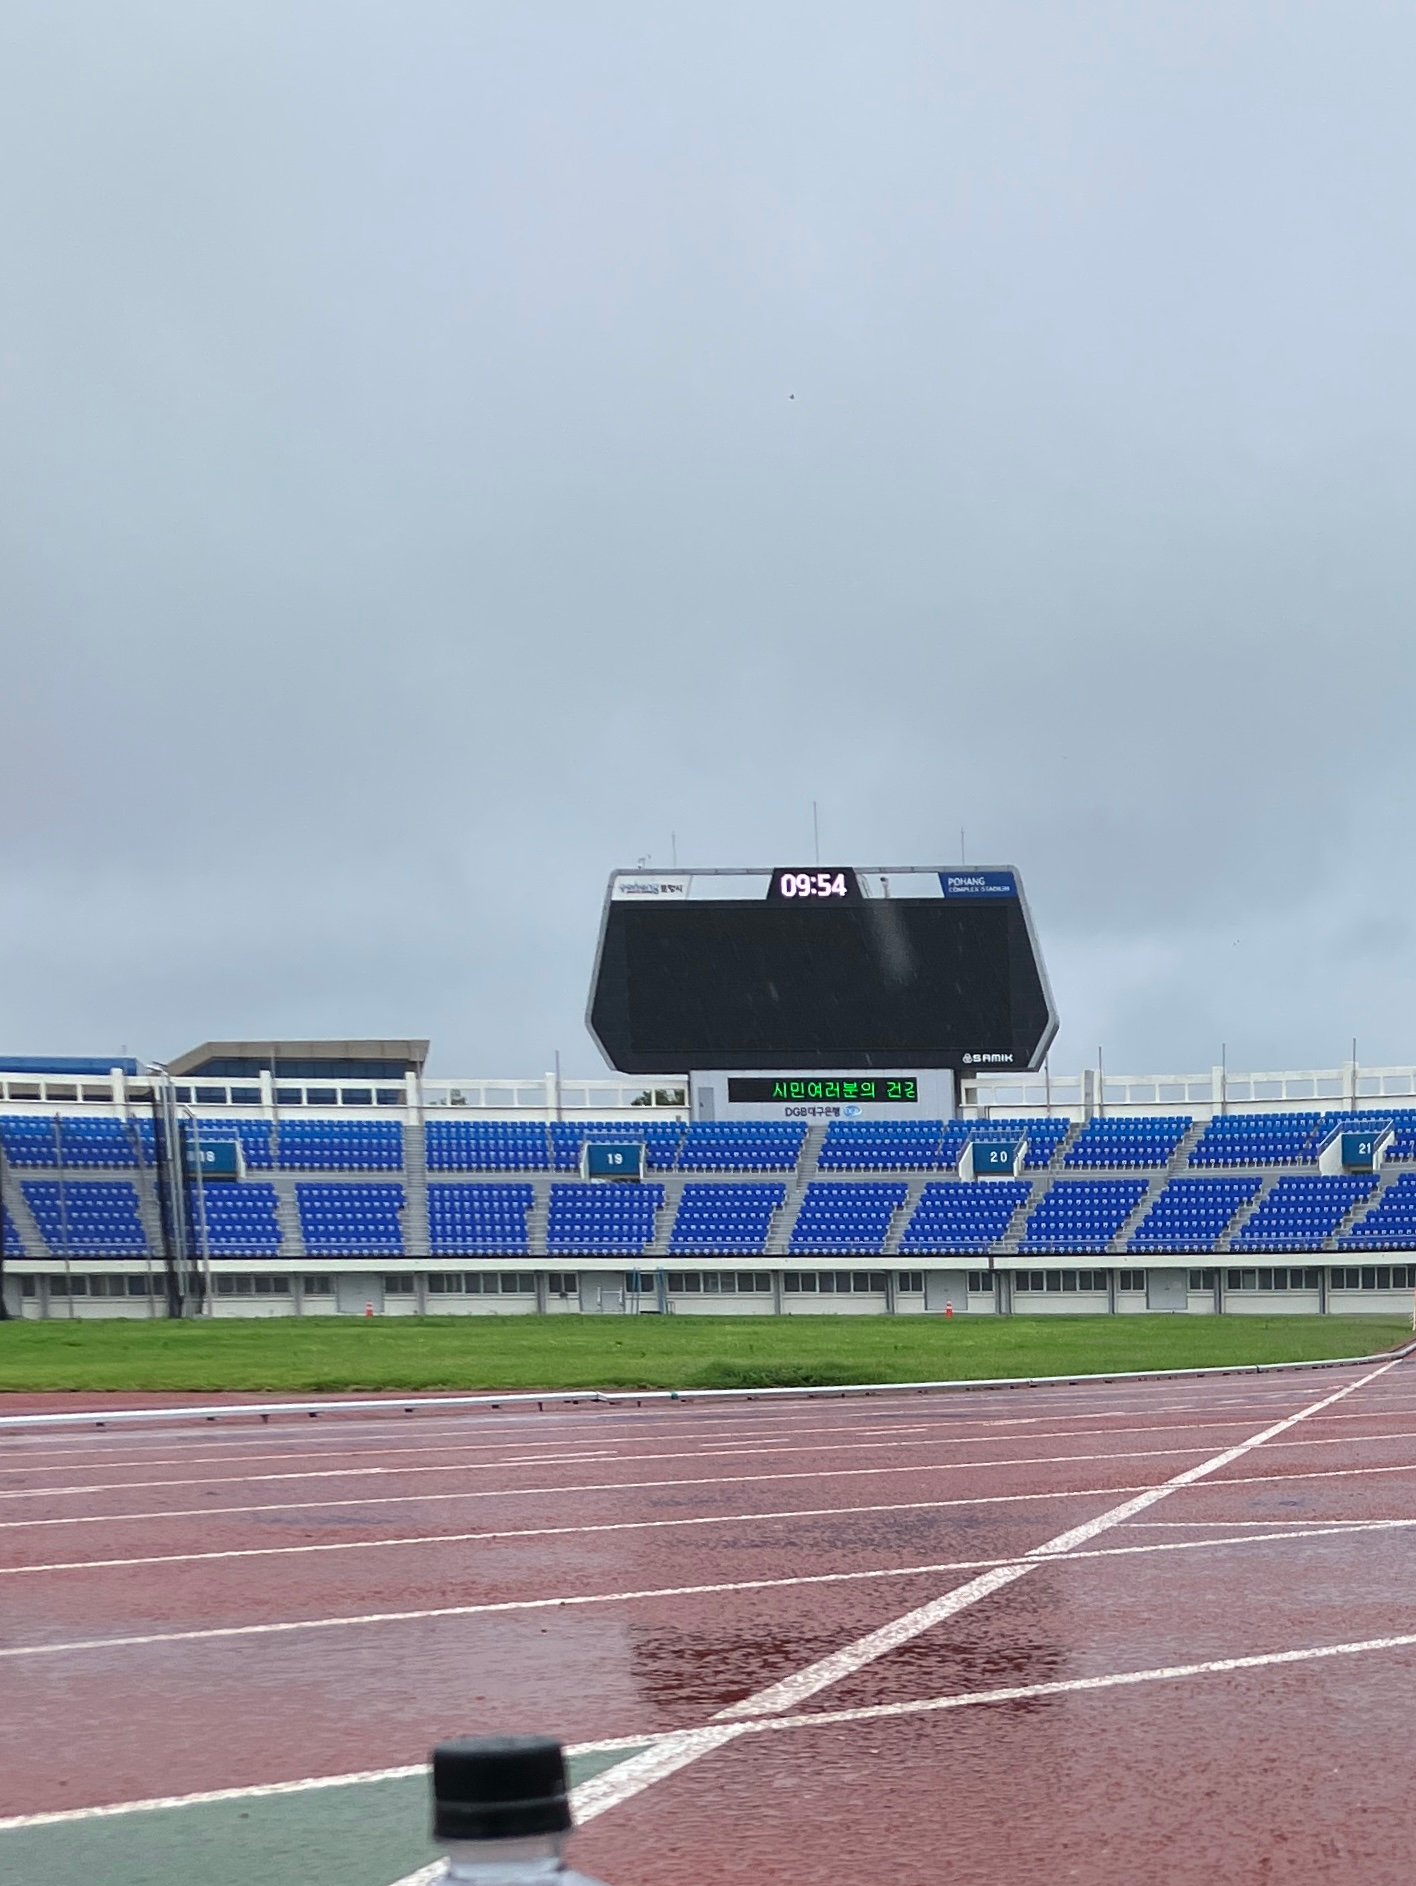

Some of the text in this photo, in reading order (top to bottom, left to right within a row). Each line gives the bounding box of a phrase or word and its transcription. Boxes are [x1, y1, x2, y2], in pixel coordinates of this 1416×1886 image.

[780, 873, 848, 897] 09:54
[947, 876, 986, 887] POHANG
[972, 1053, 1014, 1063] SAMIK
[772, 1081, 876, 1099] 시민여러분의
[1358, 1142, 1371, 1155] 21
[607, 1152, 624, 1165] 19
[990, 1150, 1008, 1163] 20
